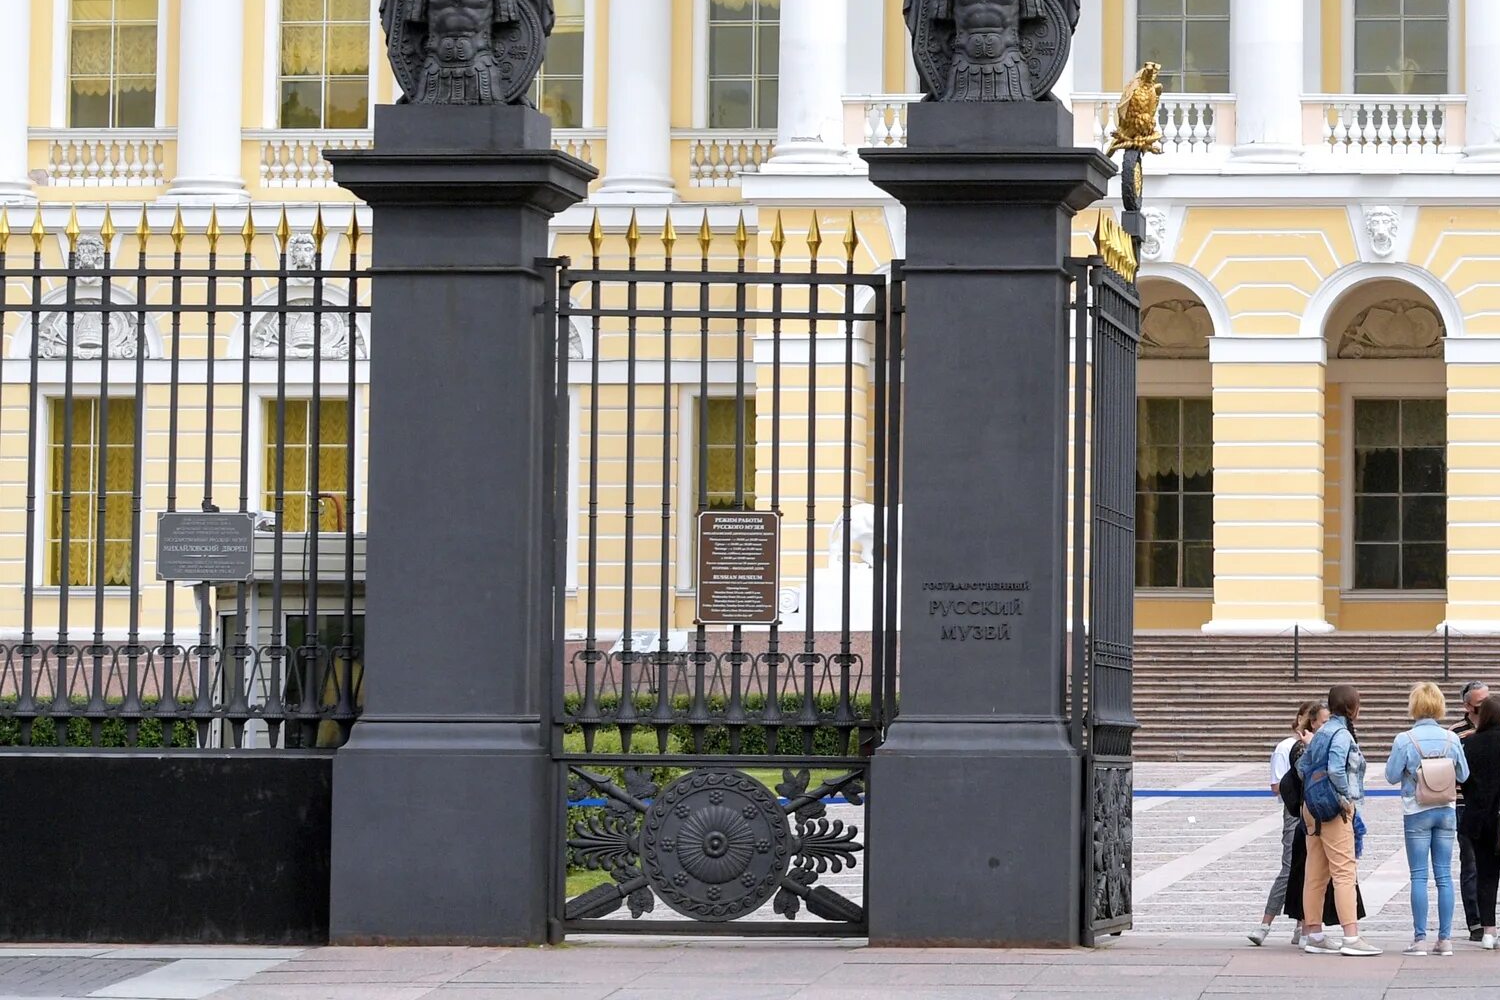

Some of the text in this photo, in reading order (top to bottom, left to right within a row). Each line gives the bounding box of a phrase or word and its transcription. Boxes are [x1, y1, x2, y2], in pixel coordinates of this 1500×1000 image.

[221, 545, 248, 553] ДВОРЕЦ
[922, 581, 1031, 591] ГОСУДАРСТВЕННЫЙ
[929, 599, 1023, 617] РУССКИЙ
[941, 623, 1011, 641] МУЗЕЙ
